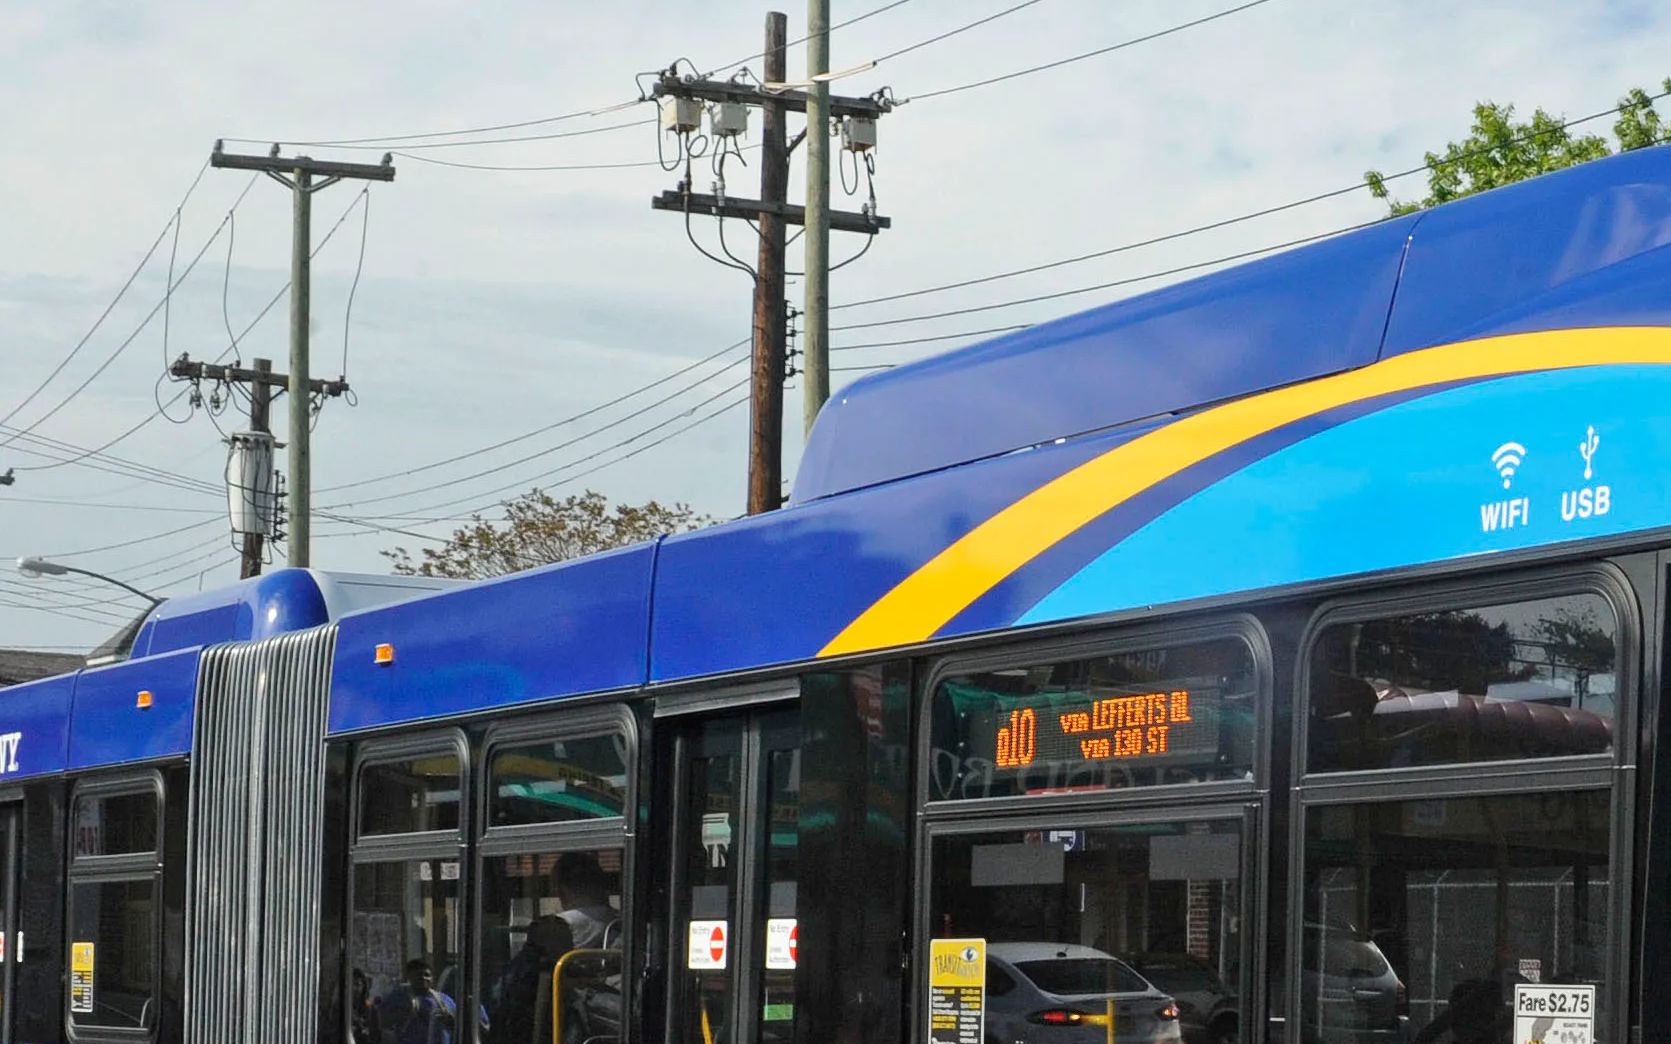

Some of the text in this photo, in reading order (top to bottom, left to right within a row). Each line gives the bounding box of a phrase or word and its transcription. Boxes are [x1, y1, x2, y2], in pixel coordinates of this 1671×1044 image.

[1481, 497, 1529, 532] WIFI
[1561, 485, 1611, 521] USB
[1092, 693, 1168, 731] LEFFERTS
[995, 708, 1036, 768] Q10
[1113, 727, 1143, 757] 130
[1147, 725, 1170, 754] ST
[1519, 992, 1590, 1013] Fare $2.75
